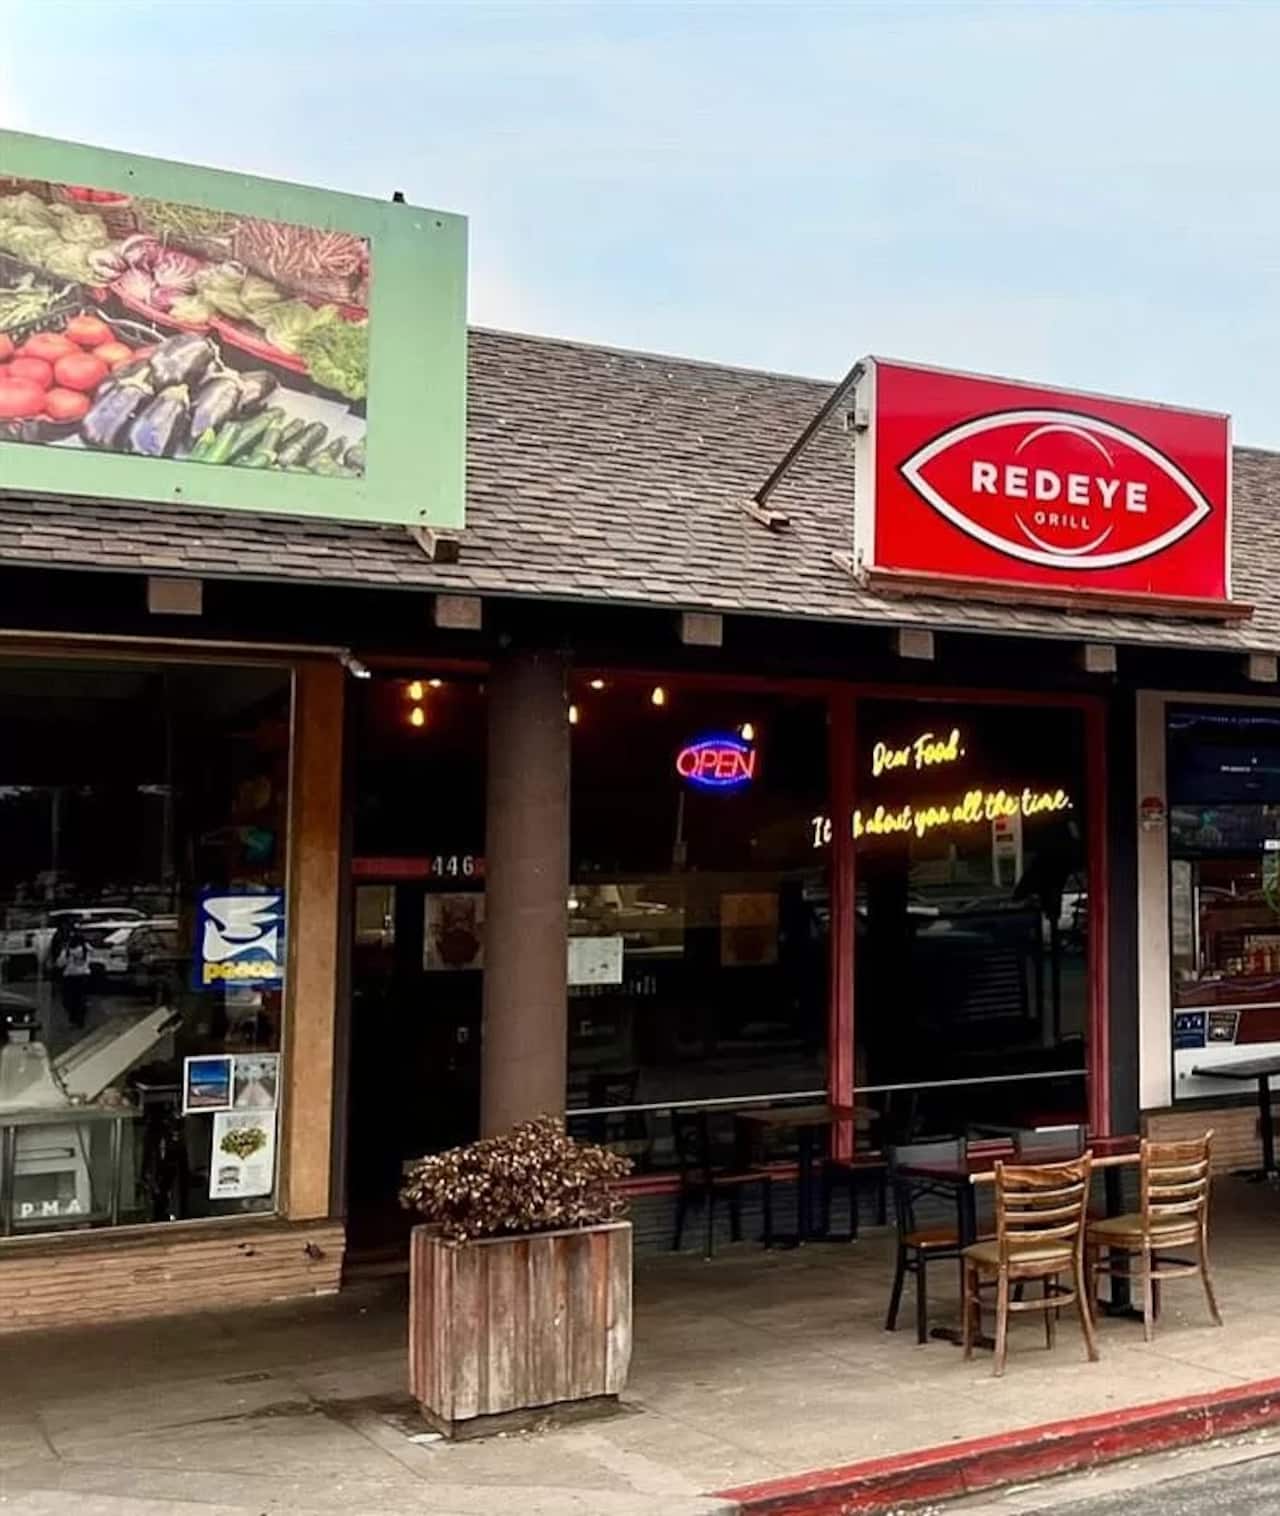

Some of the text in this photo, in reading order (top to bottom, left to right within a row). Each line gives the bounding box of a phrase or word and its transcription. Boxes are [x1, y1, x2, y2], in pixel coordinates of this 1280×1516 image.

[971, 460, 1149, 512] REDEYE
[1033, 511, 1091, 530] GRILL
[676, 747, 756, 779] OPEN
[871, 742, 911, 776] Dear
[865, 805, 912, 835] about
[914, 805, 950, 838] you
[984, 788, 1021, 820] the
[432, 855, 474, 876] 446
